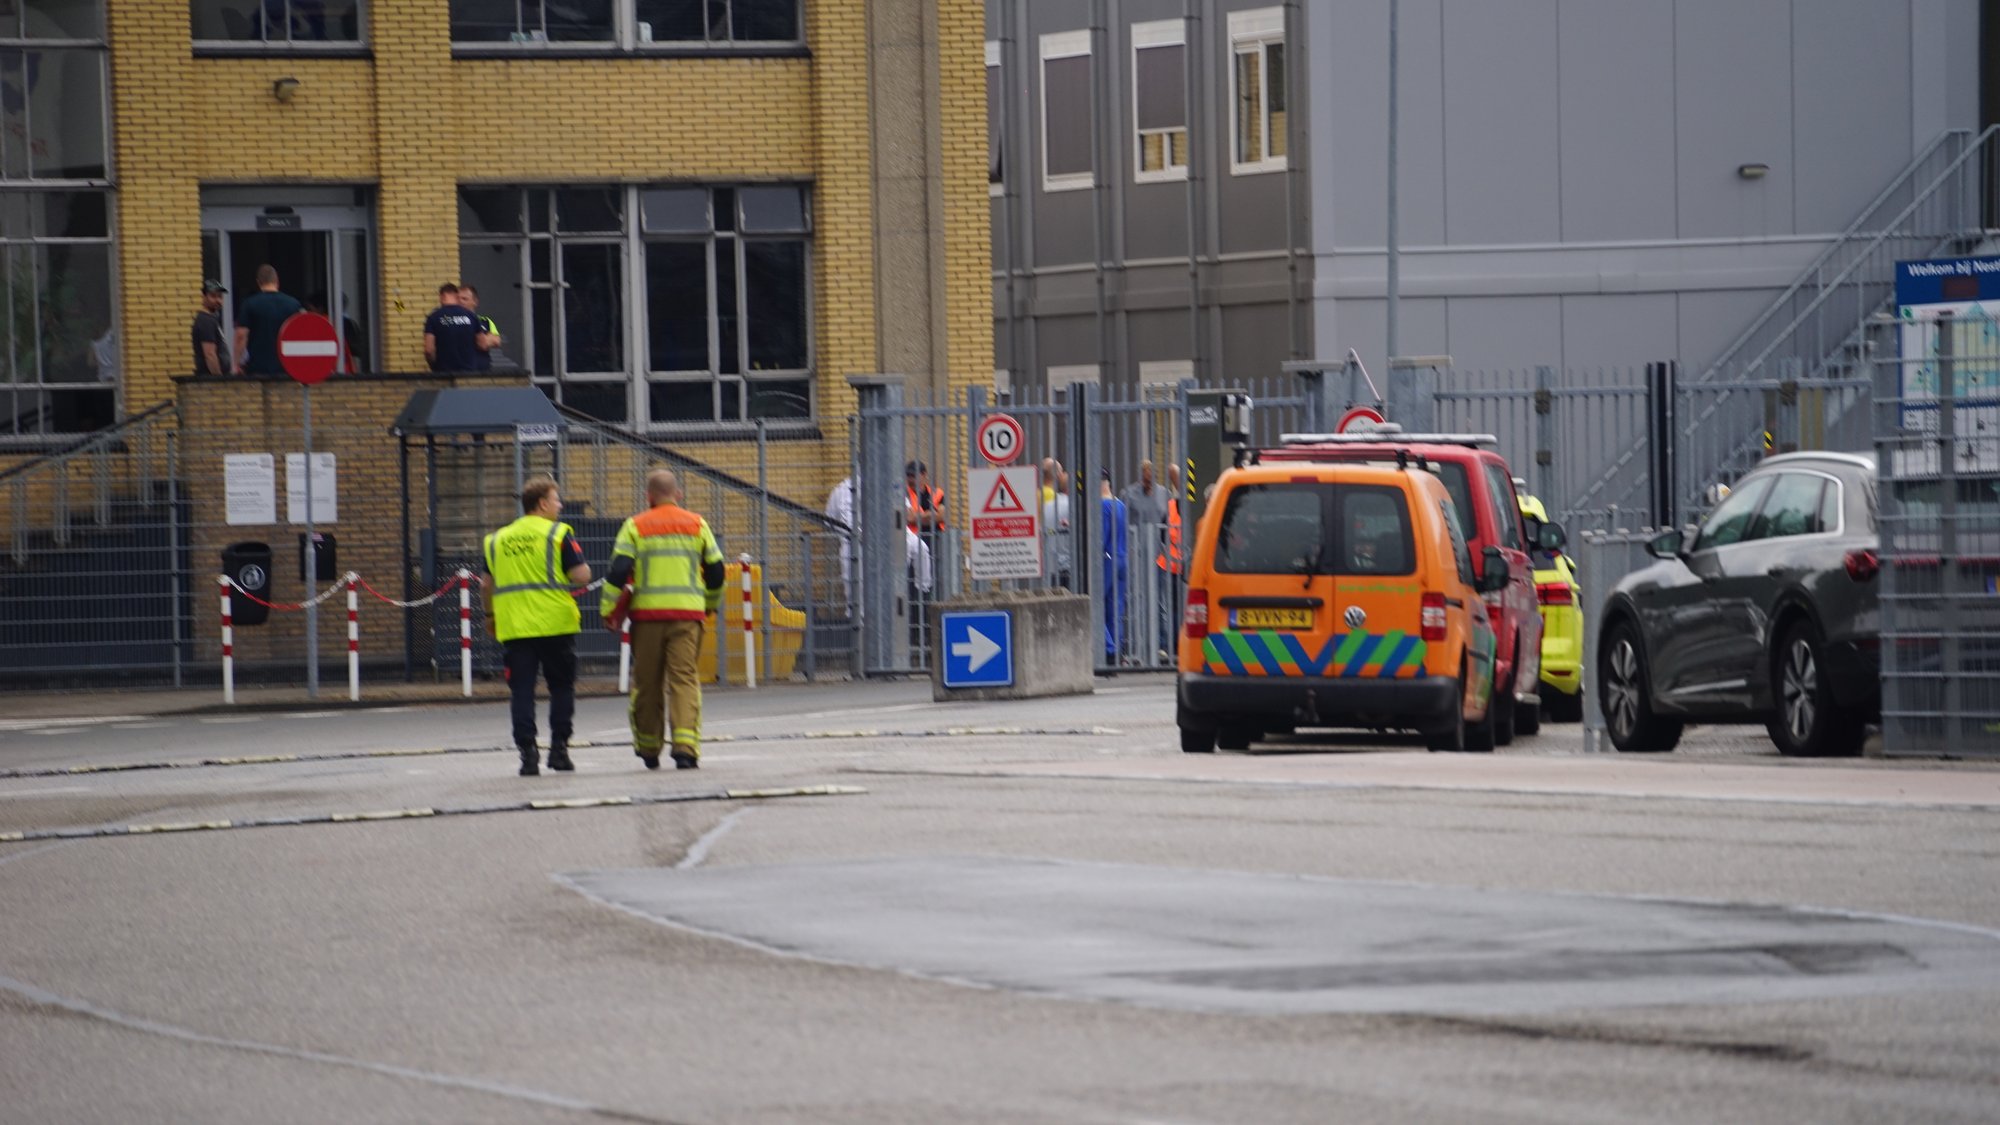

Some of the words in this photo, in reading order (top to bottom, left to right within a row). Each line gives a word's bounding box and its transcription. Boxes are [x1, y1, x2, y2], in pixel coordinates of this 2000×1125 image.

[1907, 262, 1955, 277] Welkom
[1956, 260, 1972, 276] bij
[987, 429, 1013, 451] 10
